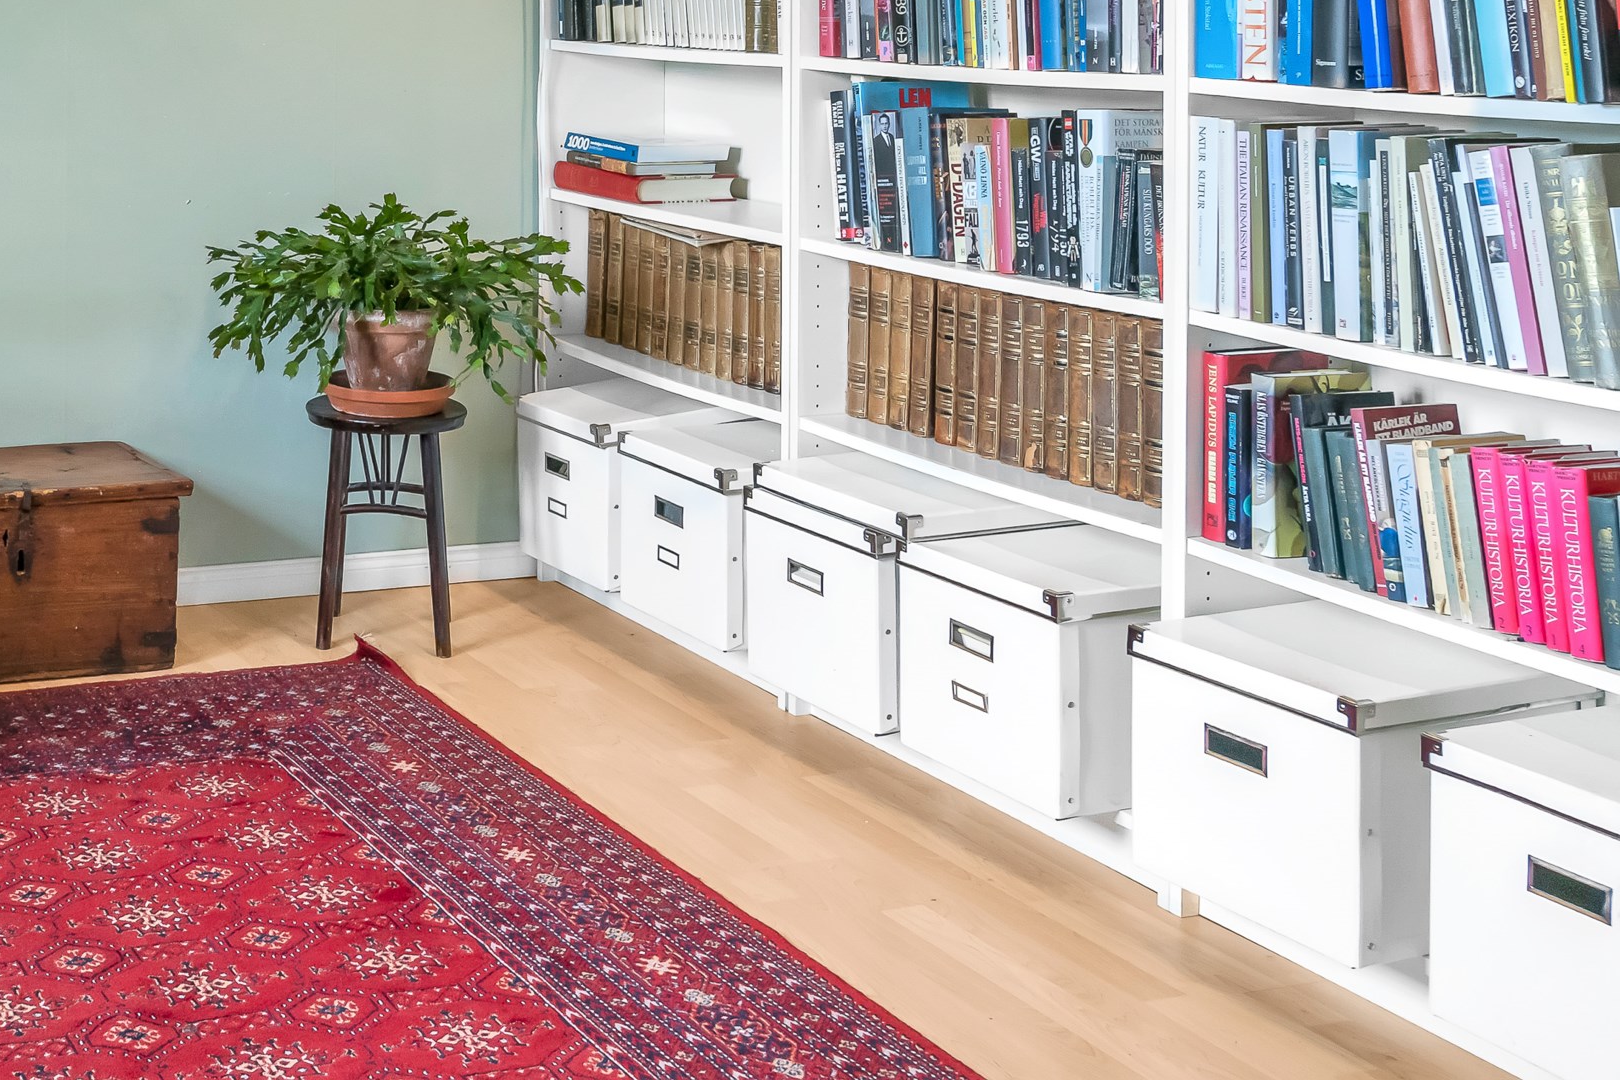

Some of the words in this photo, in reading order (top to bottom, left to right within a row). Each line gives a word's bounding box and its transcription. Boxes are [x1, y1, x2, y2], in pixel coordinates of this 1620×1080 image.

[1204, 5, 1212, 30] Stokstad
[899, 88, 932, 108] LEN
[1114, 119, 1132, 127] DET
[1133, 118, 1160, 127] STORA
[1114, 127, 1132, 136] FÖR
[568, 135, 590, 150] 1000
[1030, 135, 1042, 164] GW
[1198, 126, 1206, 162] NATUR
[1239, 139, 1247, 160] THE
[980, 176, 988, 198] LINNA
[1142, 189, 1151, 201] SJU
[1197, 170, 1206, 209] KULTUR
[1239, 161, 1248, 202] ITALIAN
[1288, 176, 1297, 216] URBAN
[837, 174, 849, 222] HATET
[950, 164, 965, 237] D-DAGEN
[1015, 219, 1029, 248] 1793
[1143, 202, 1152, 237] KUNGARS
[1144, 238, 1154, 255] DÖD
[1239, 203, 1248, 271] RENAISSANCE
[1207, 365, 1218, 393] JENS
[1257, 392, 1267, 411] KLAS
[1207, 396, 1218, 447] LAPIDUS
[1257, 412, 1269, 454] ÖSTERGREN
[1294, 418, 1304, 453] MATS-ERIC
[1353, 422, 1365, 450] KÄRLEK
[1373, 416, 1412, 432] KÄRLEK
[1414, 412, 1428, 424] ÄR
[1298, 454, 1307, 484] NILSSON
[1358, 452, 1368, 463] ÄR
[1361, 463, 1369, 475] ETT
[1257, 458, 1267, 498] GANGSTERS
[1208, 483, 1217, 504] CASH
[1301, 485, 1310, 503] ÄKTA
[1361, 476, 1377, 523] BLANDBAND
[1477, 467, 1506, 608] KULTURHISTORIA
[1505, 474, 1533, 615] KULTURHISTORIA
[1530, 480, 1559, 624] KULTURHISTORIA
[1559, 488, 1588, 634] KULTURHISTORIA
